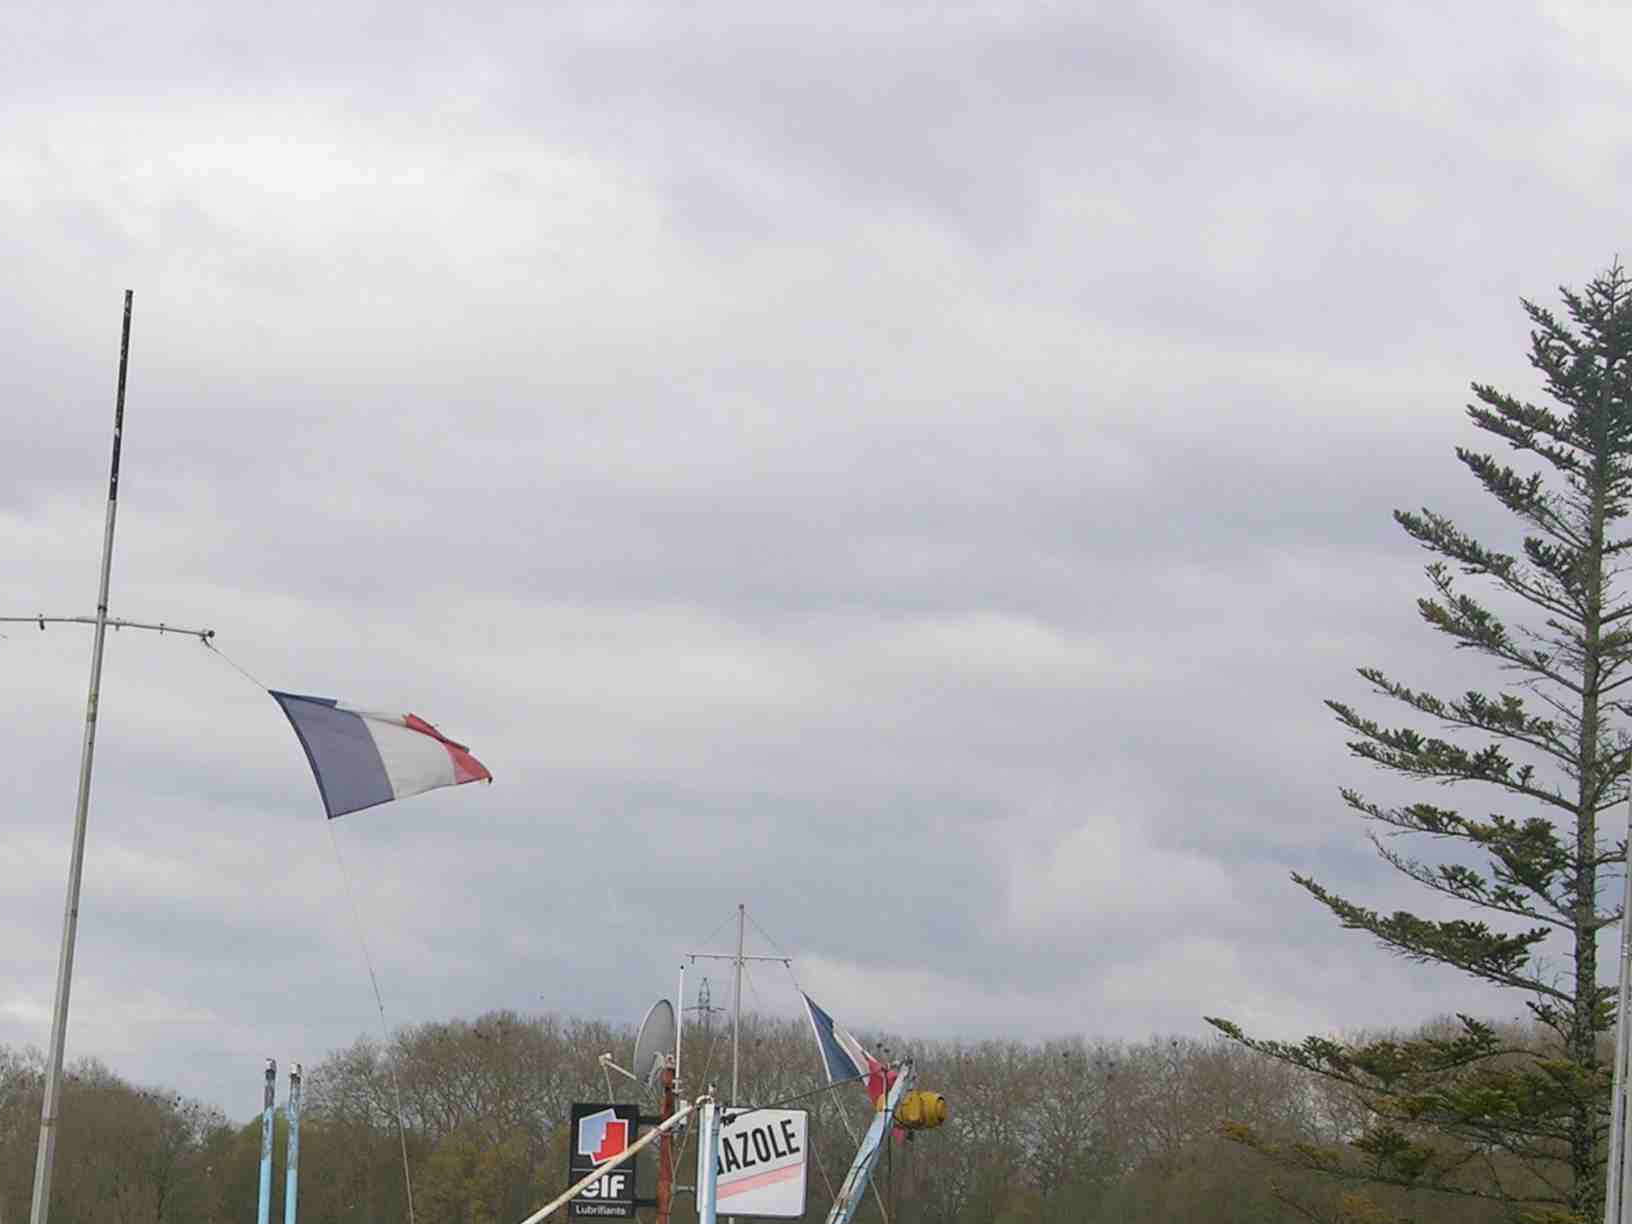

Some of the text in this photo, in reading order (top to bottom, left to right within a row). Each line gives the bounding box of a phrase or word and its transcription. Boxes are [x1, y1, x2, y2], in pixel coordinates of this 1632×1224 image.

[717, 1119, 801, 1176] AZOLE
[580, 1174, 625, 1198] elf
[575, 1204, 626, 1216] Lubrifiants
